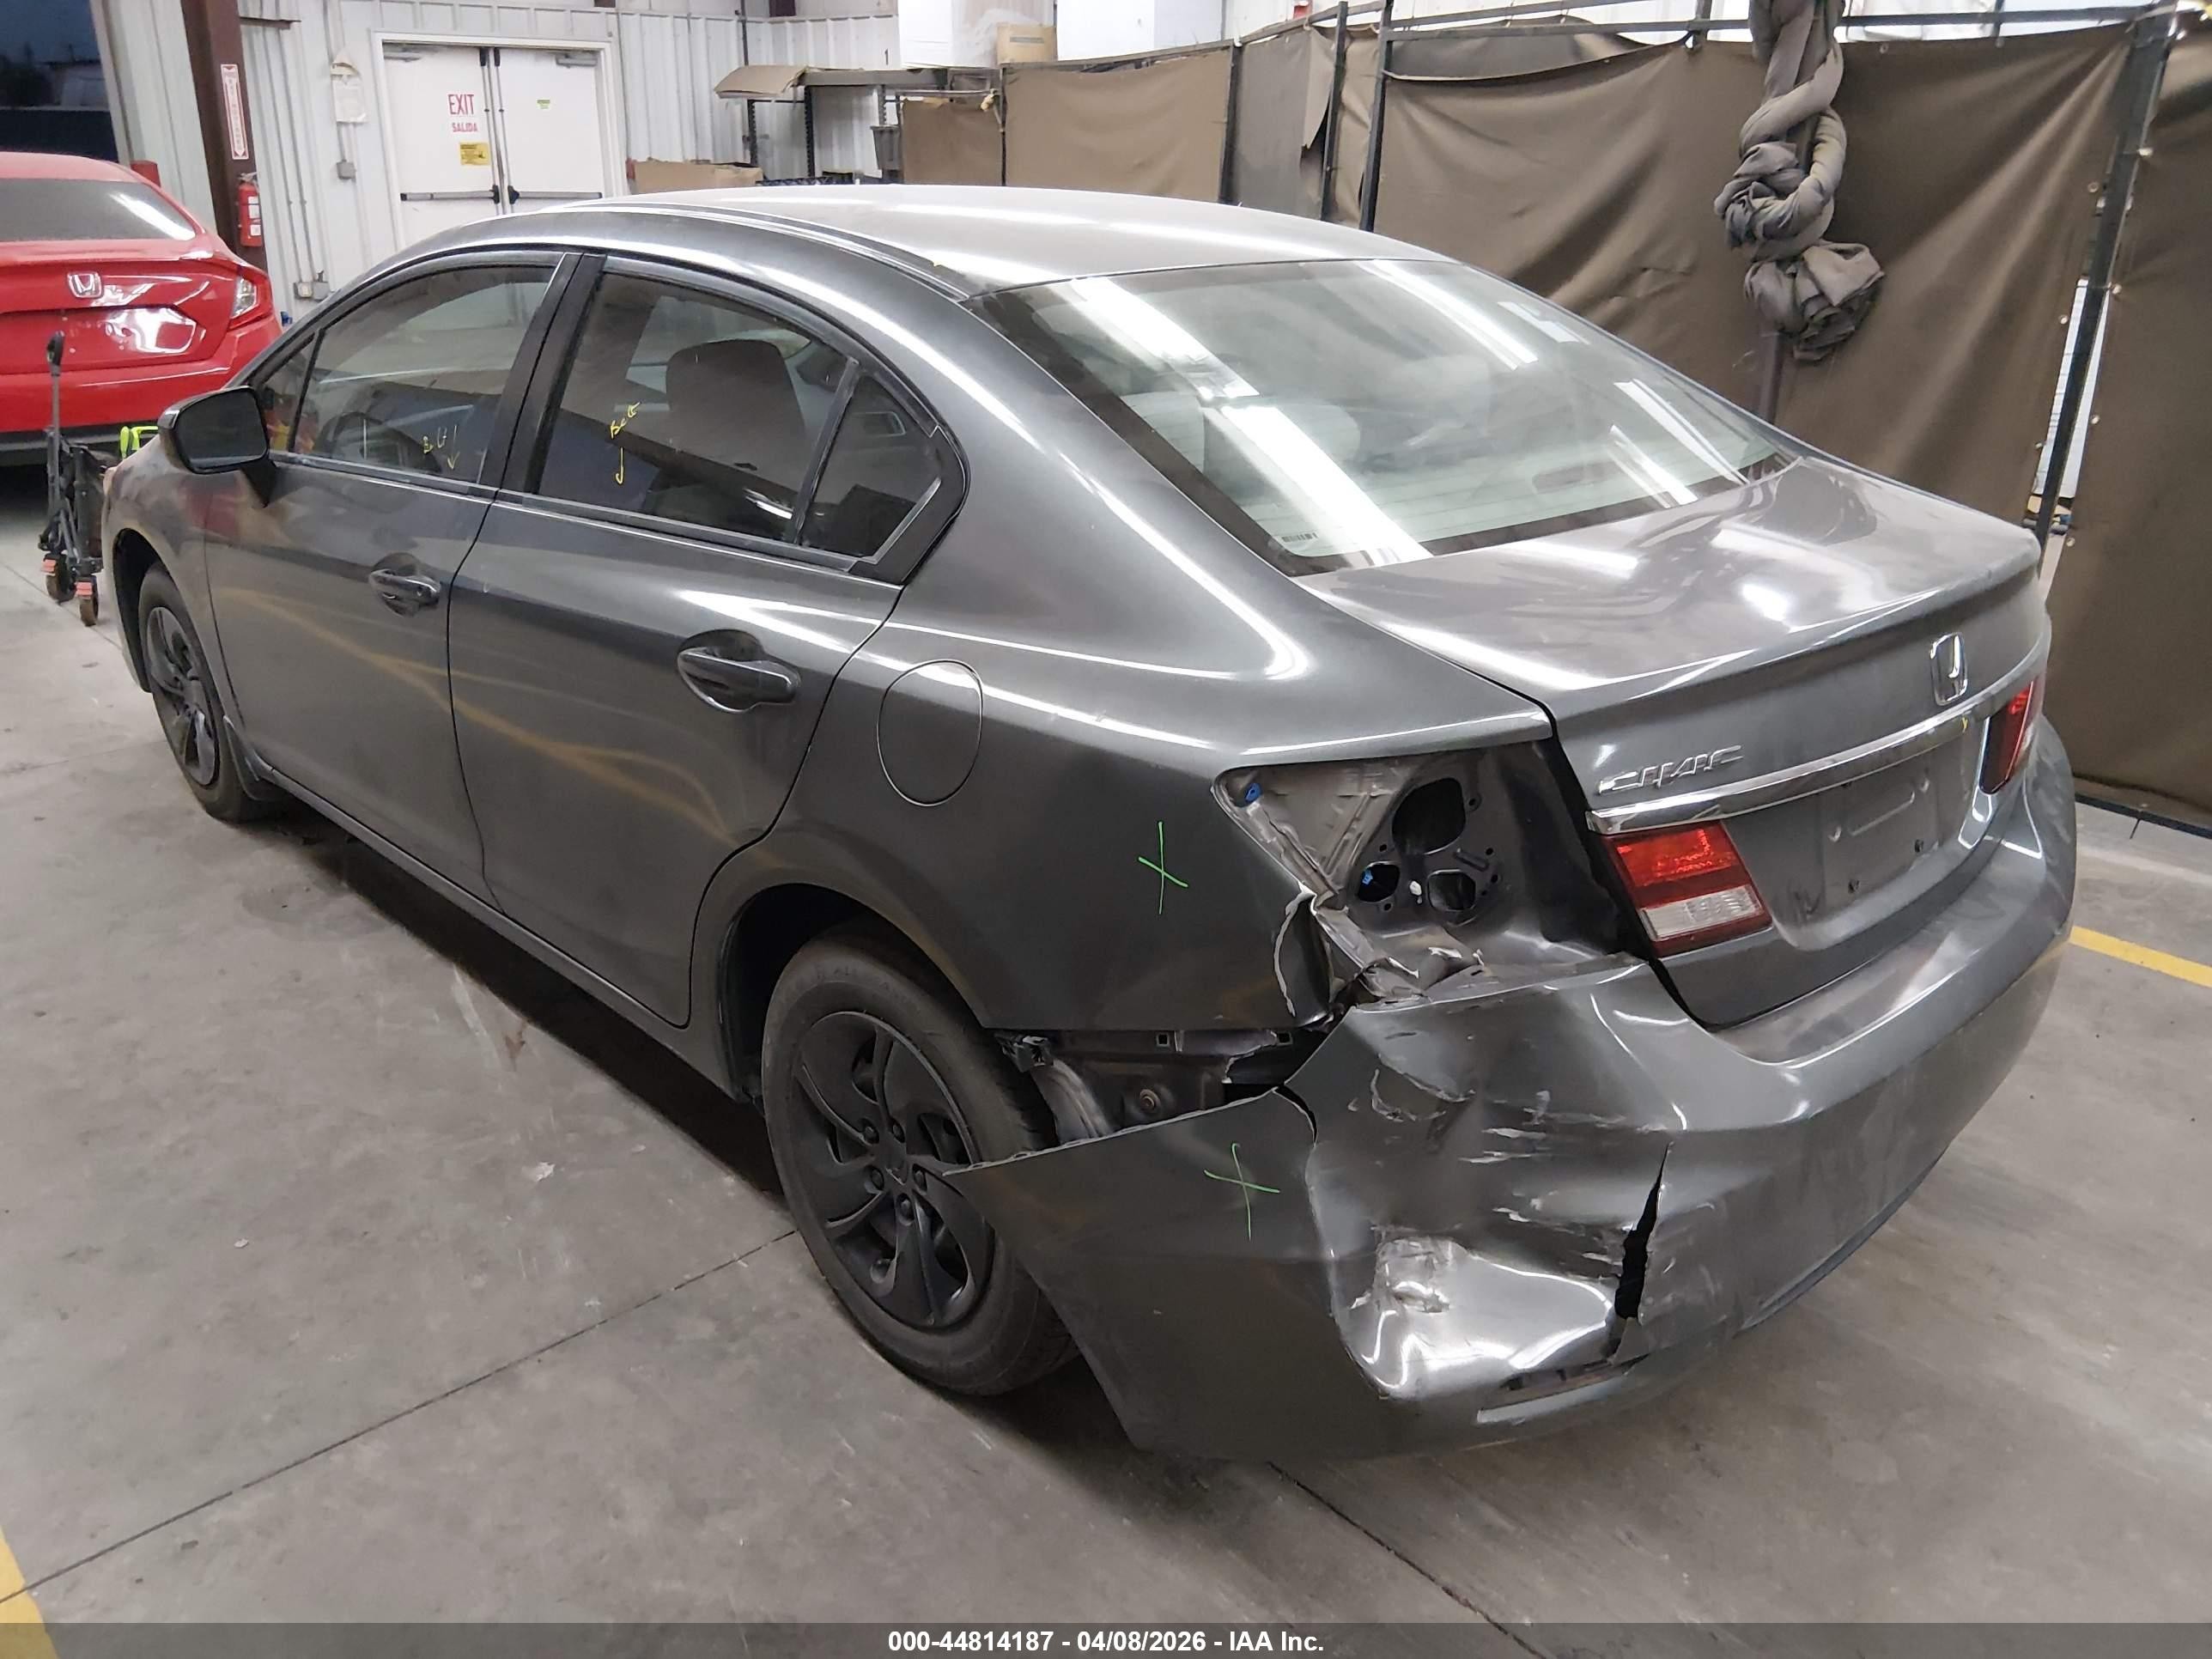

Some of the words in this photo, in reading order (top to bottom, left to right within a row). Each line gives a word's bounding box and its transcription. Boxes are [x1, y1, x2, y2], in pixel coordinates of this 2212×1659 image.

[447, 94, 475, 115] EXIT
[452, 122, 478, 132] SALIDA
[1597, 744, 1743, 794] CIVIC
